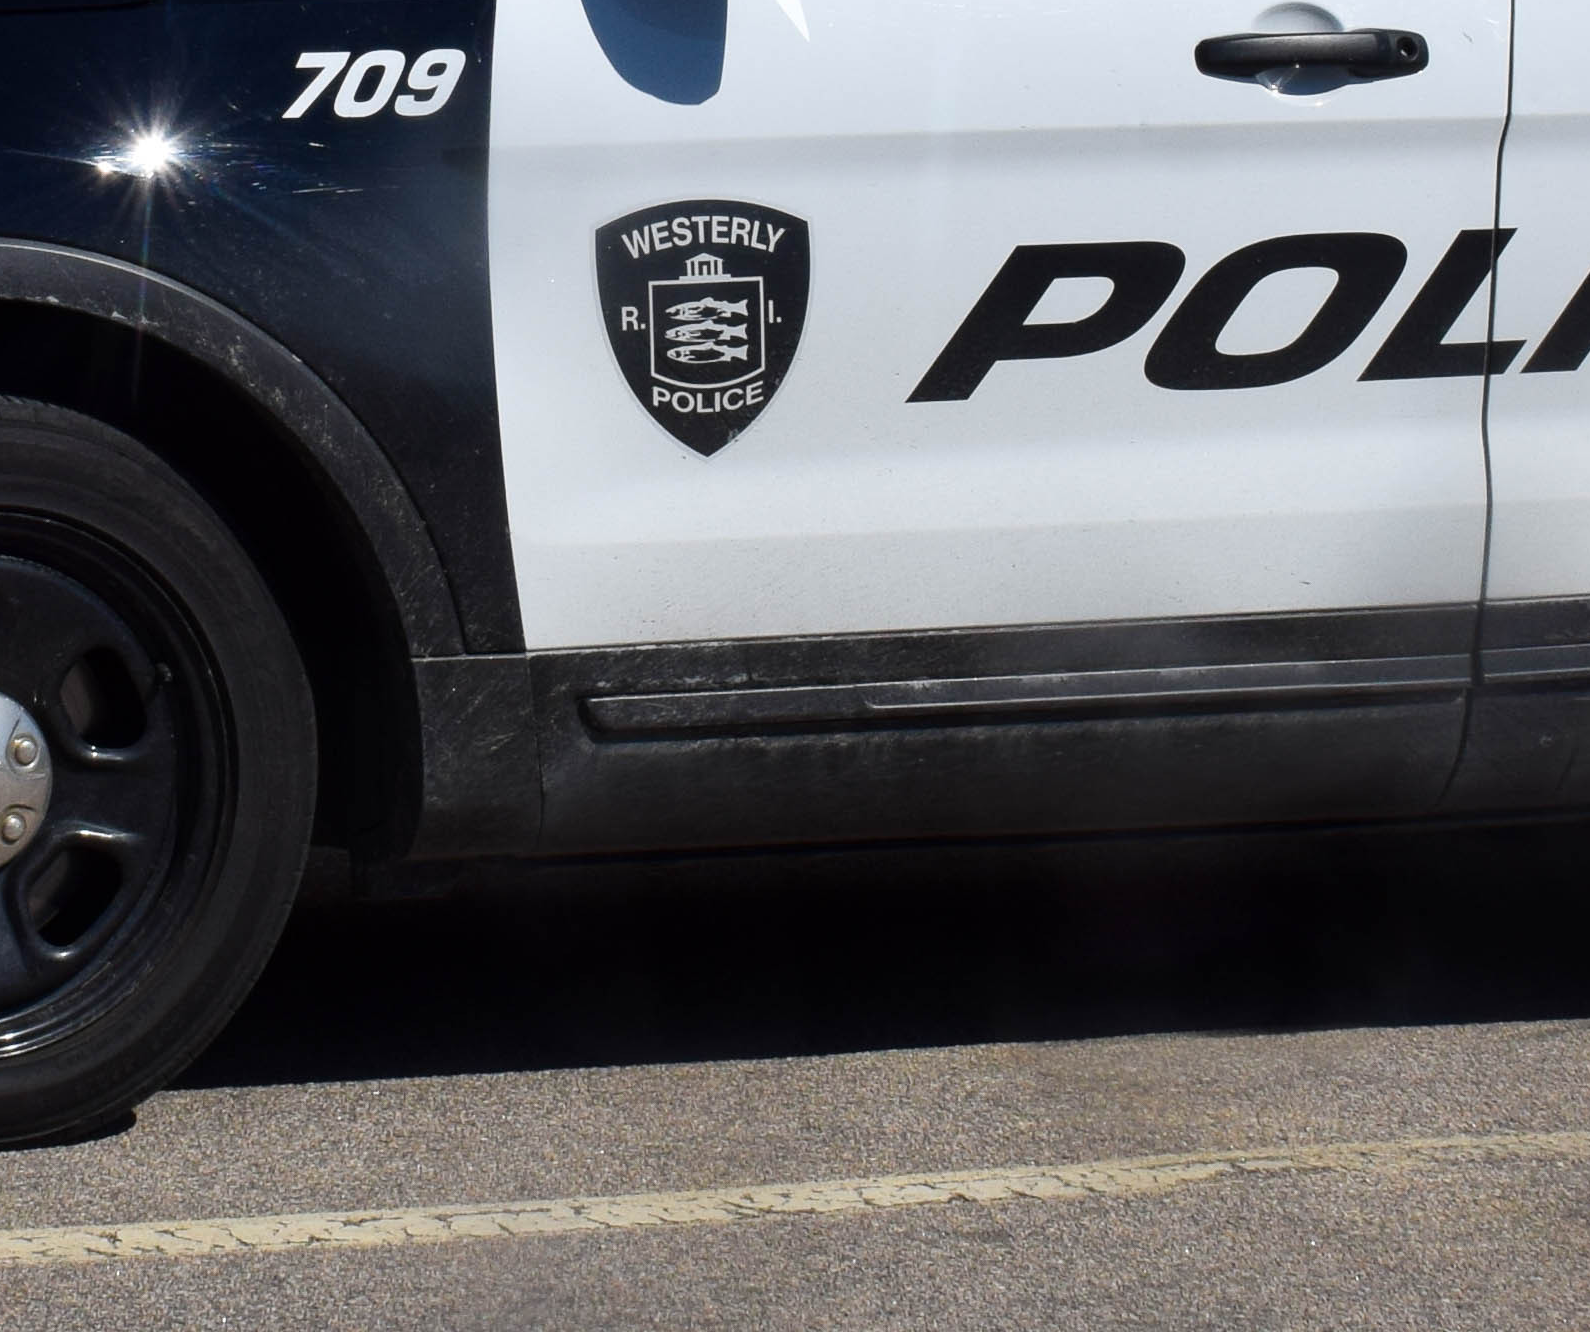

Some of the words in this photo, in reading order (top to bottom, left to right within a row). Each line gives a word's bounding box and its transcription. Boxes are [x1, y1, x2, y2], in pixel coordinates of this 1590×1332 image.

[282, 49, 466, 118] 709
[621, 215, 786, 259] WESTERLY
[621, 306, 646, 331] R.
[768, 299, 782, 324] I.
[652, 380, 764, 413] POLICE
